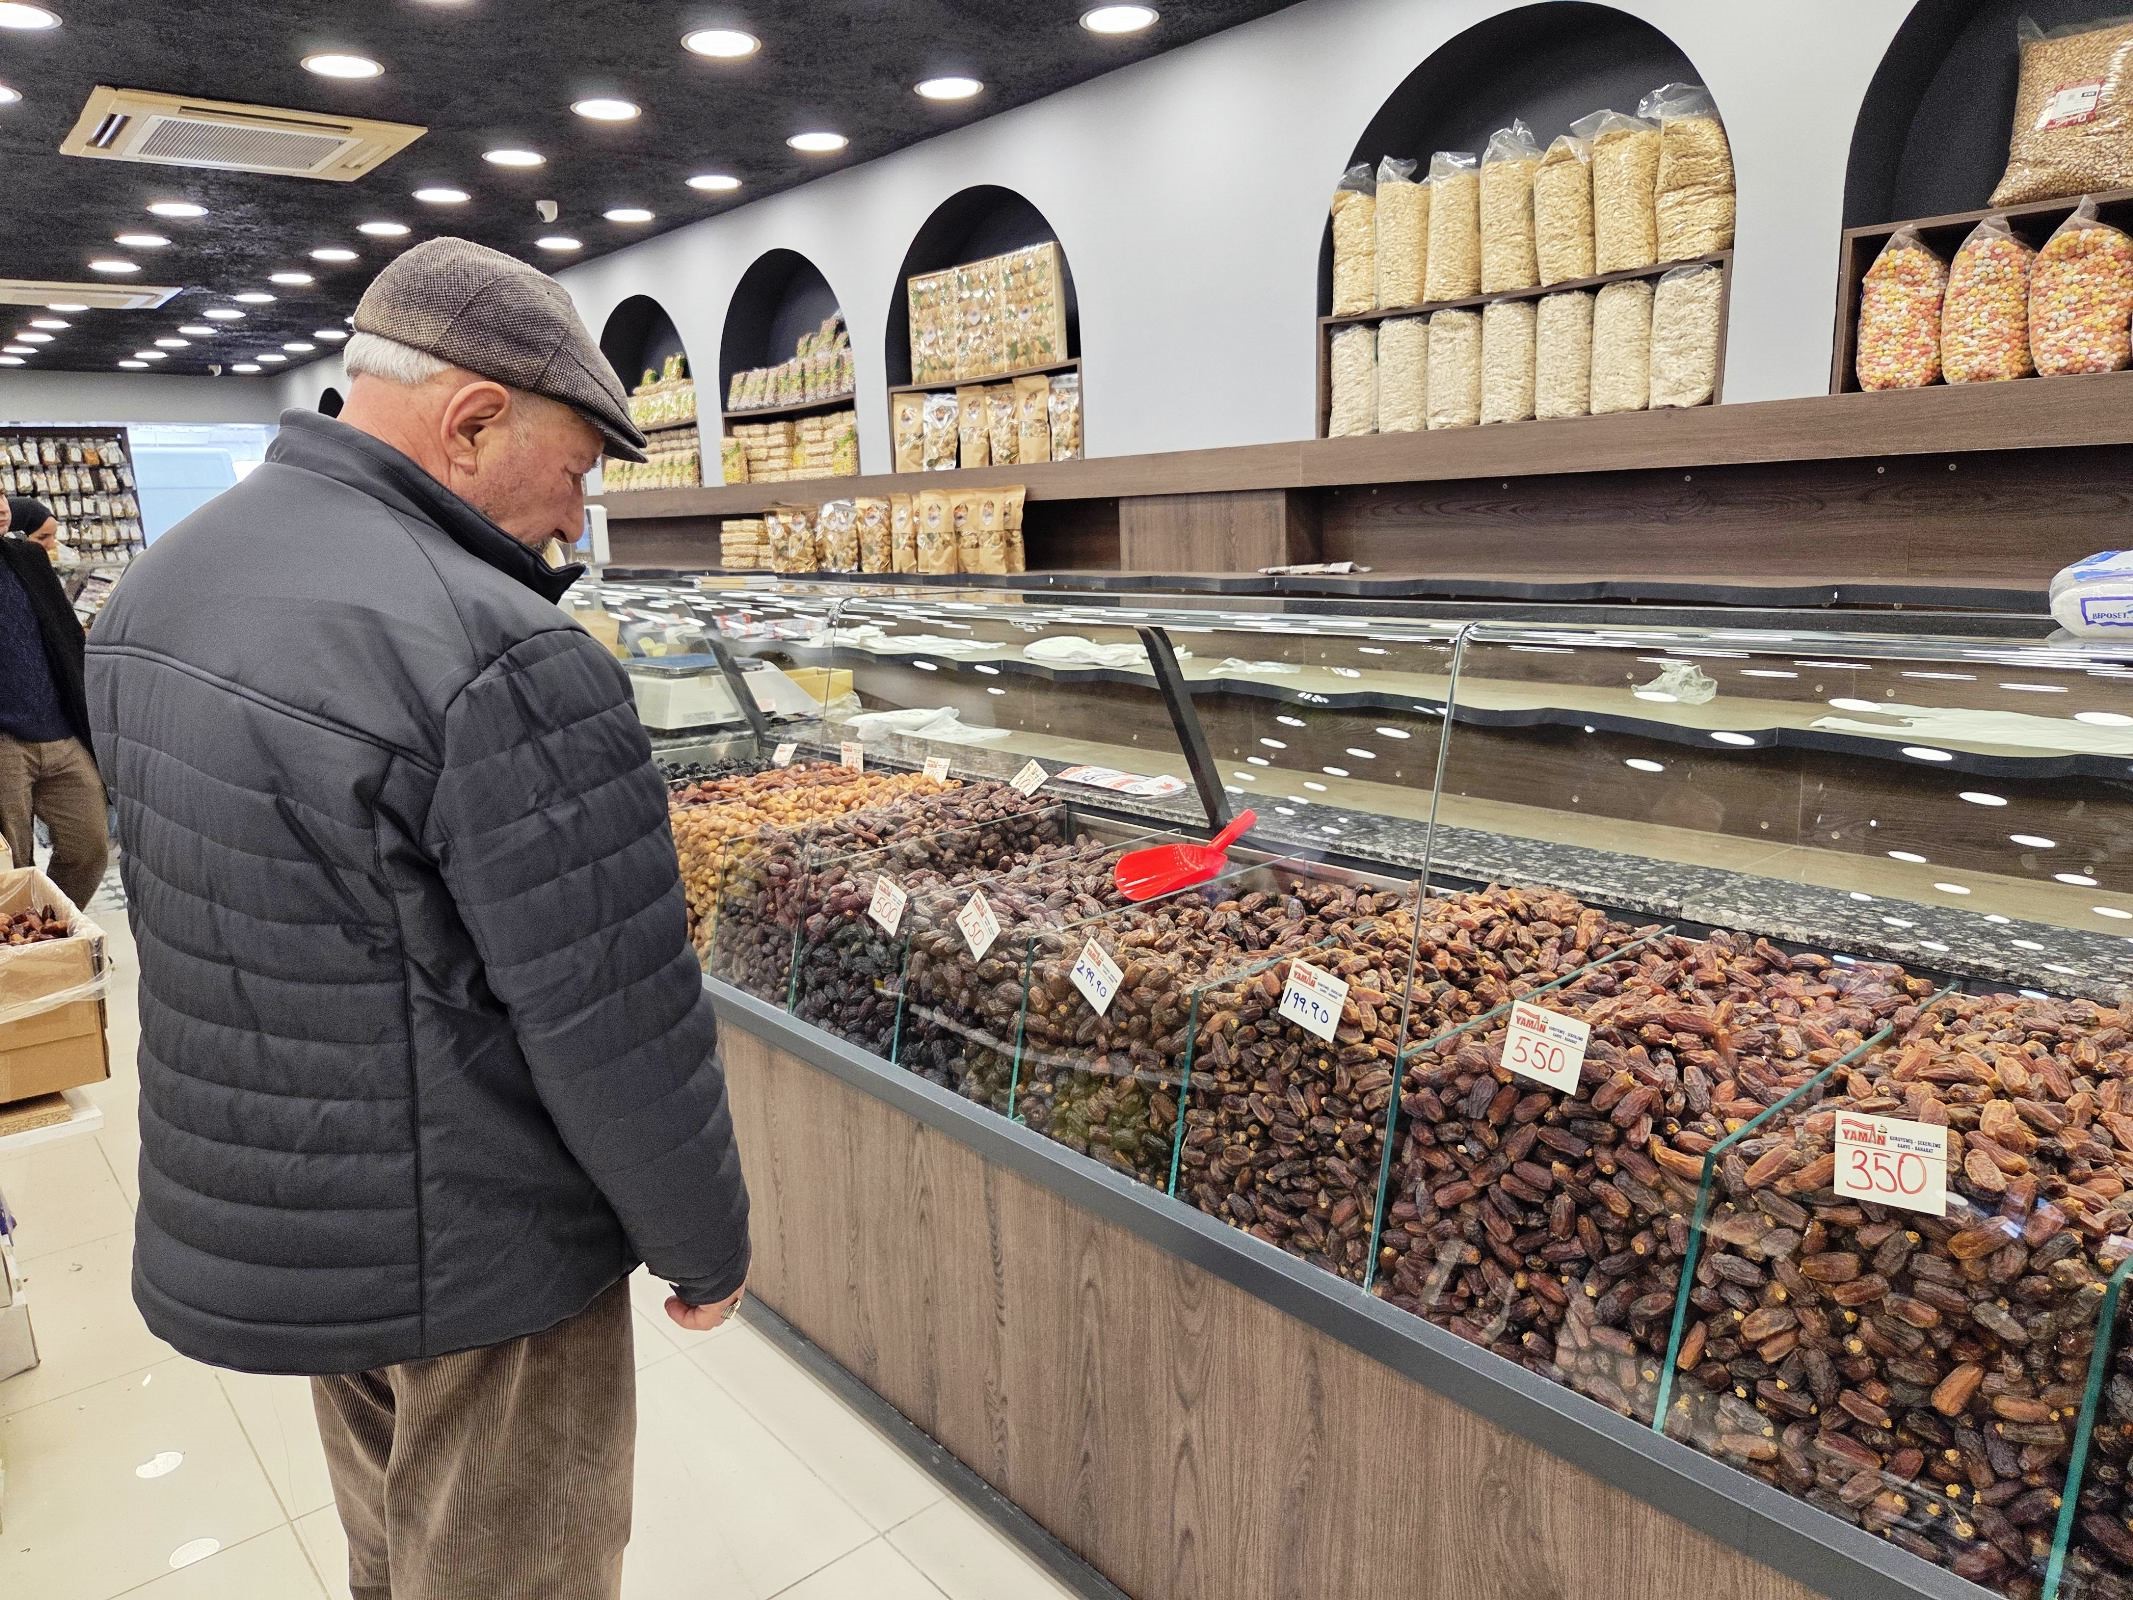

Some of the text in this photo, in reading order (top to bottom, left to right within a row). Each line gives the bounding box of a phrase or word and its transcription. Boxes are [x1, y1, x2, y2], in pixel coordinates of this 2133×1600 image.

[873, 897, 898, 924] 500
[962, 911, 985, 946] 450
[1076, 959, 1107, 998] 299.90
[1284, 987, 1329, 1024] 199.90
[1516, 1014, 1547, 1034] YAMAN
[1512, 1035, 1566, 1073] 550
[1841, 1124, 1887, 1146] YAMAN
[1845, 1149, 1927, 1195] 350
